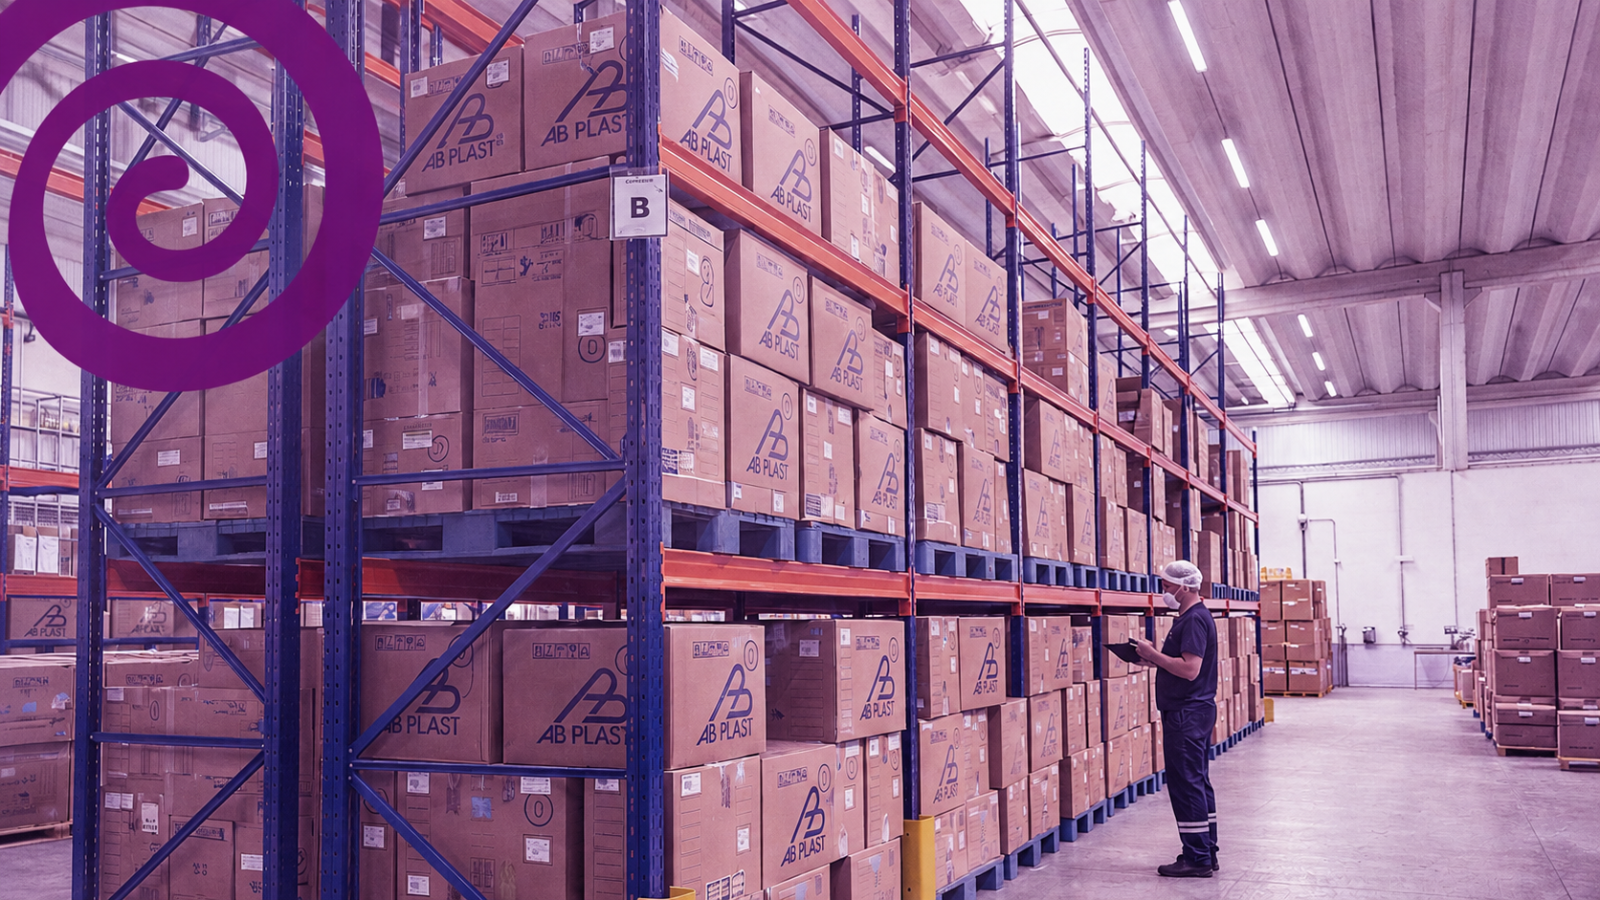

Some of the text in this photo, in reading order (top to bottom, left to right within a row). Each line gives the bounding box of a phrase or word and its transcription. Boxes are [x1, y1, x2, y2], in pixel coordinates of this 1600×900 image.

[541, 124, 569, 147] AB
[422, 139, 495, 172] AB PLAST
[679, 128, 732, 173] AB PLAST
[630, 196, 650, 218] B
[770, 185, 812, 222] AB PLAST
[758, 330, 799, 361] AB PLAST
[830, 366, 863, 393] AB PLAST
[746, 456, 789, 481] AB PLAST
[973, 680, 982, 696] AB
[860, 700, 895, 720] AB PLAST
[407, 716, 461, 735] PLAST
[536, 725, 566, 744] AB
[696, 717, 754, 746] AB PLAST
[933, 789, 943, 804] AB
[781, 834, 826, 867] AB PLAST
